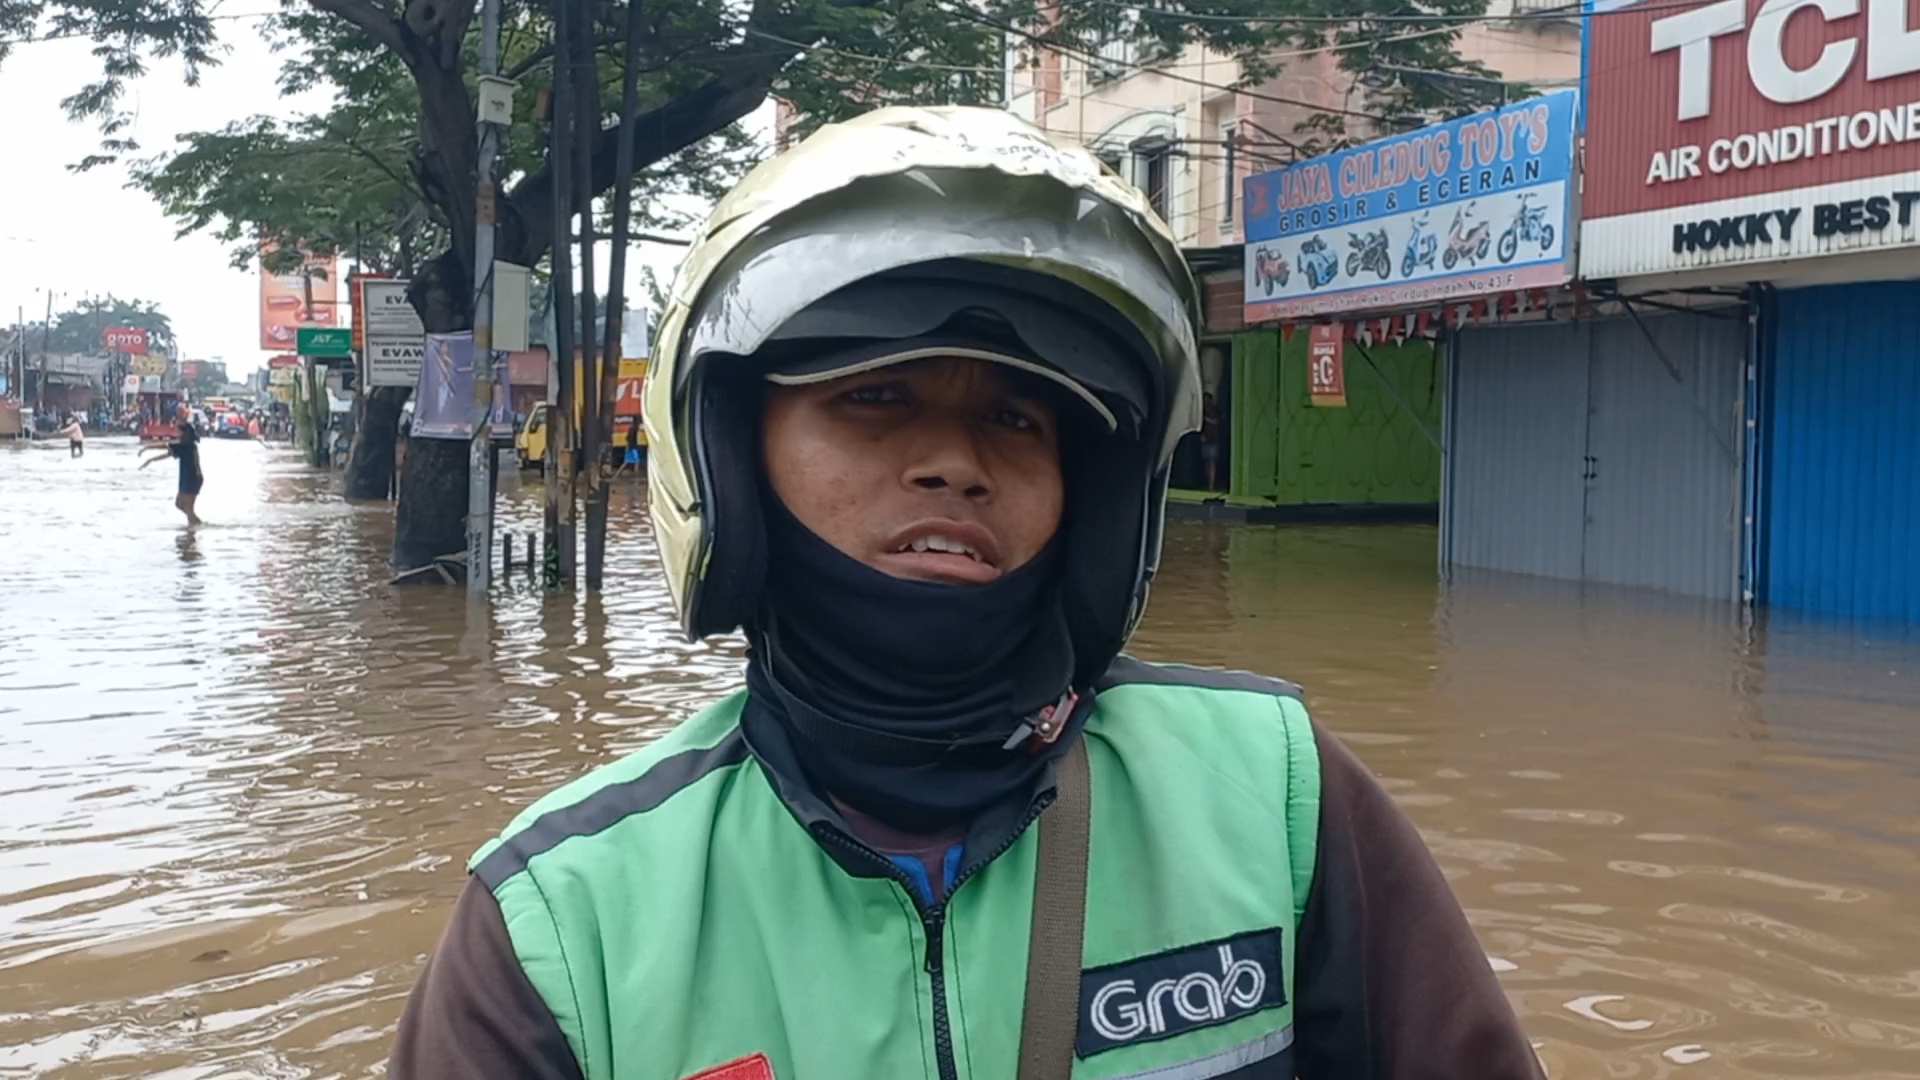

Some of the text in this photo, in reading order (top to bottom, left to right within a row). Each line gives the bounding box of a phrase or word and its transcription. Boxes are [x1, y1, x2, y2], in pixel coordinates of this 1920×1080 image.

[1651, 0, 1920, 121] TCL
[1278, 104, 1549, 212] JAYA CILEDUG TOY'S
[1279, 160, 1540, 232] GROSIR & ECERAN
[1645, 145, 1701, 185] AIR
[1672, 192, 1920, 254] HOKKY BEST
[1091, 944, 1266, 1041] Grab
